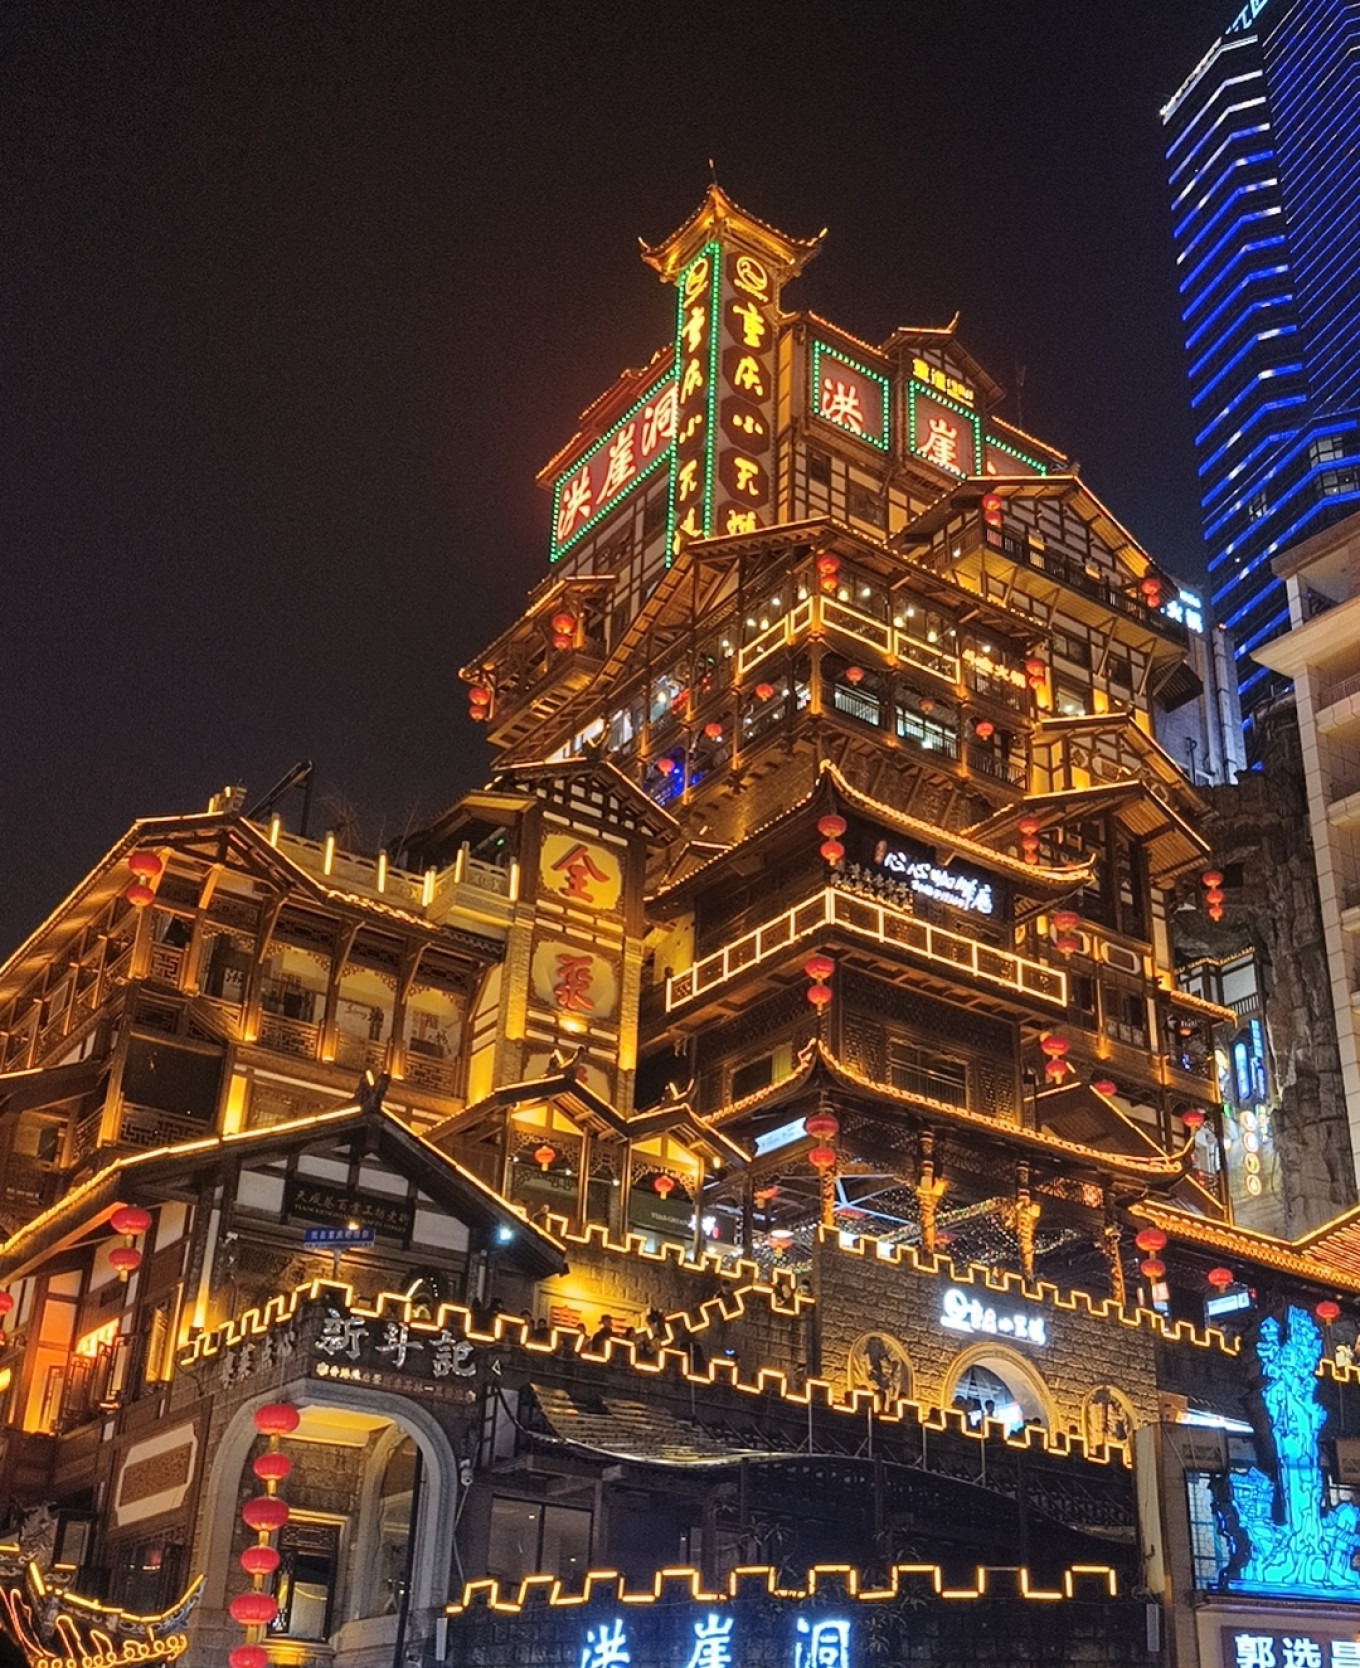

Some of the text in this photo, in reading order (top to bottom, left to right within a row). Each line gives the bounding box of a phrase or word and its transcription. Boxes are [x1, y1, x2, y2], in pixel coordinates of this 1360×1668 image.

[557, 380, 678, 541] 洪崖洞
[315, 1307, 477, 1379] 新斗記
[580, 1613, 851, 1668] 洪崖洞
